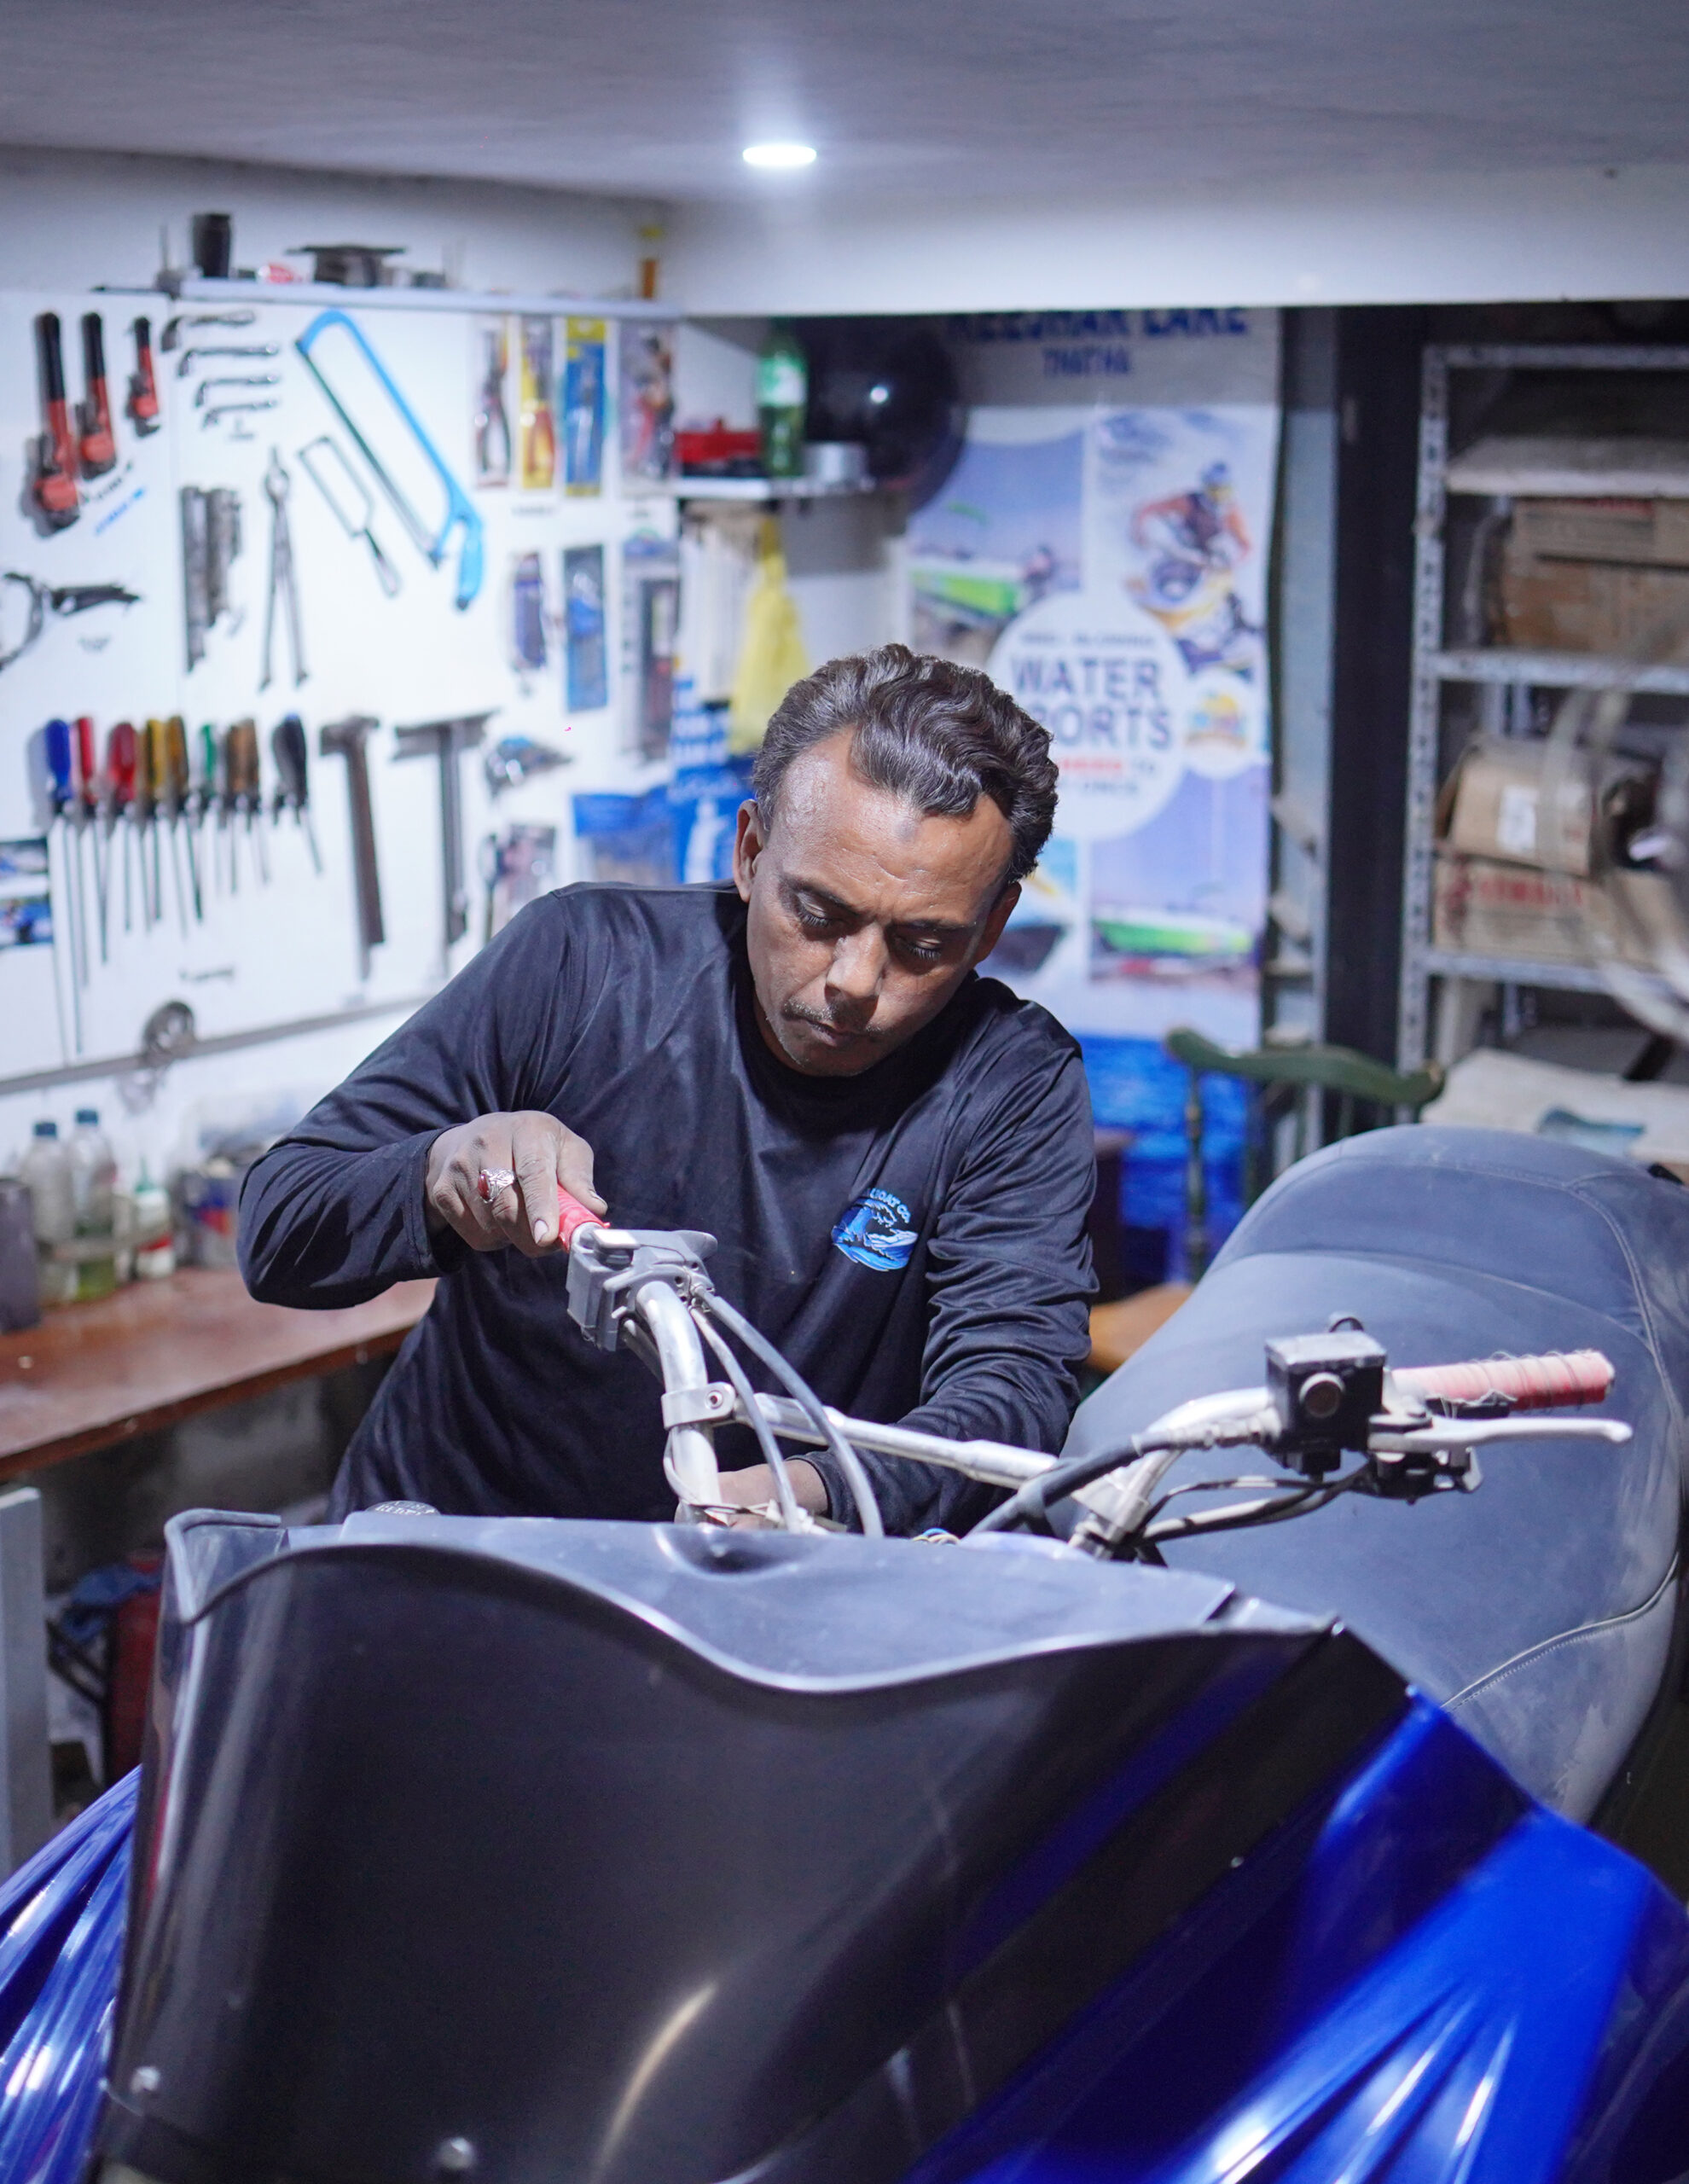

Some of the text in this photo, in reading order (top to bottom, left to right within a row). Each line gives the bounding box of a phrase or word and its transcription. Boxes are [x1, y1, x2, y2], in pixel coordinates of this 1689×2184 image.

[1145, 307, 1248, 335] LAKE
[1010, 657, 1162, 700] WATER
[1024, 704, 1172, 751] PORTS
